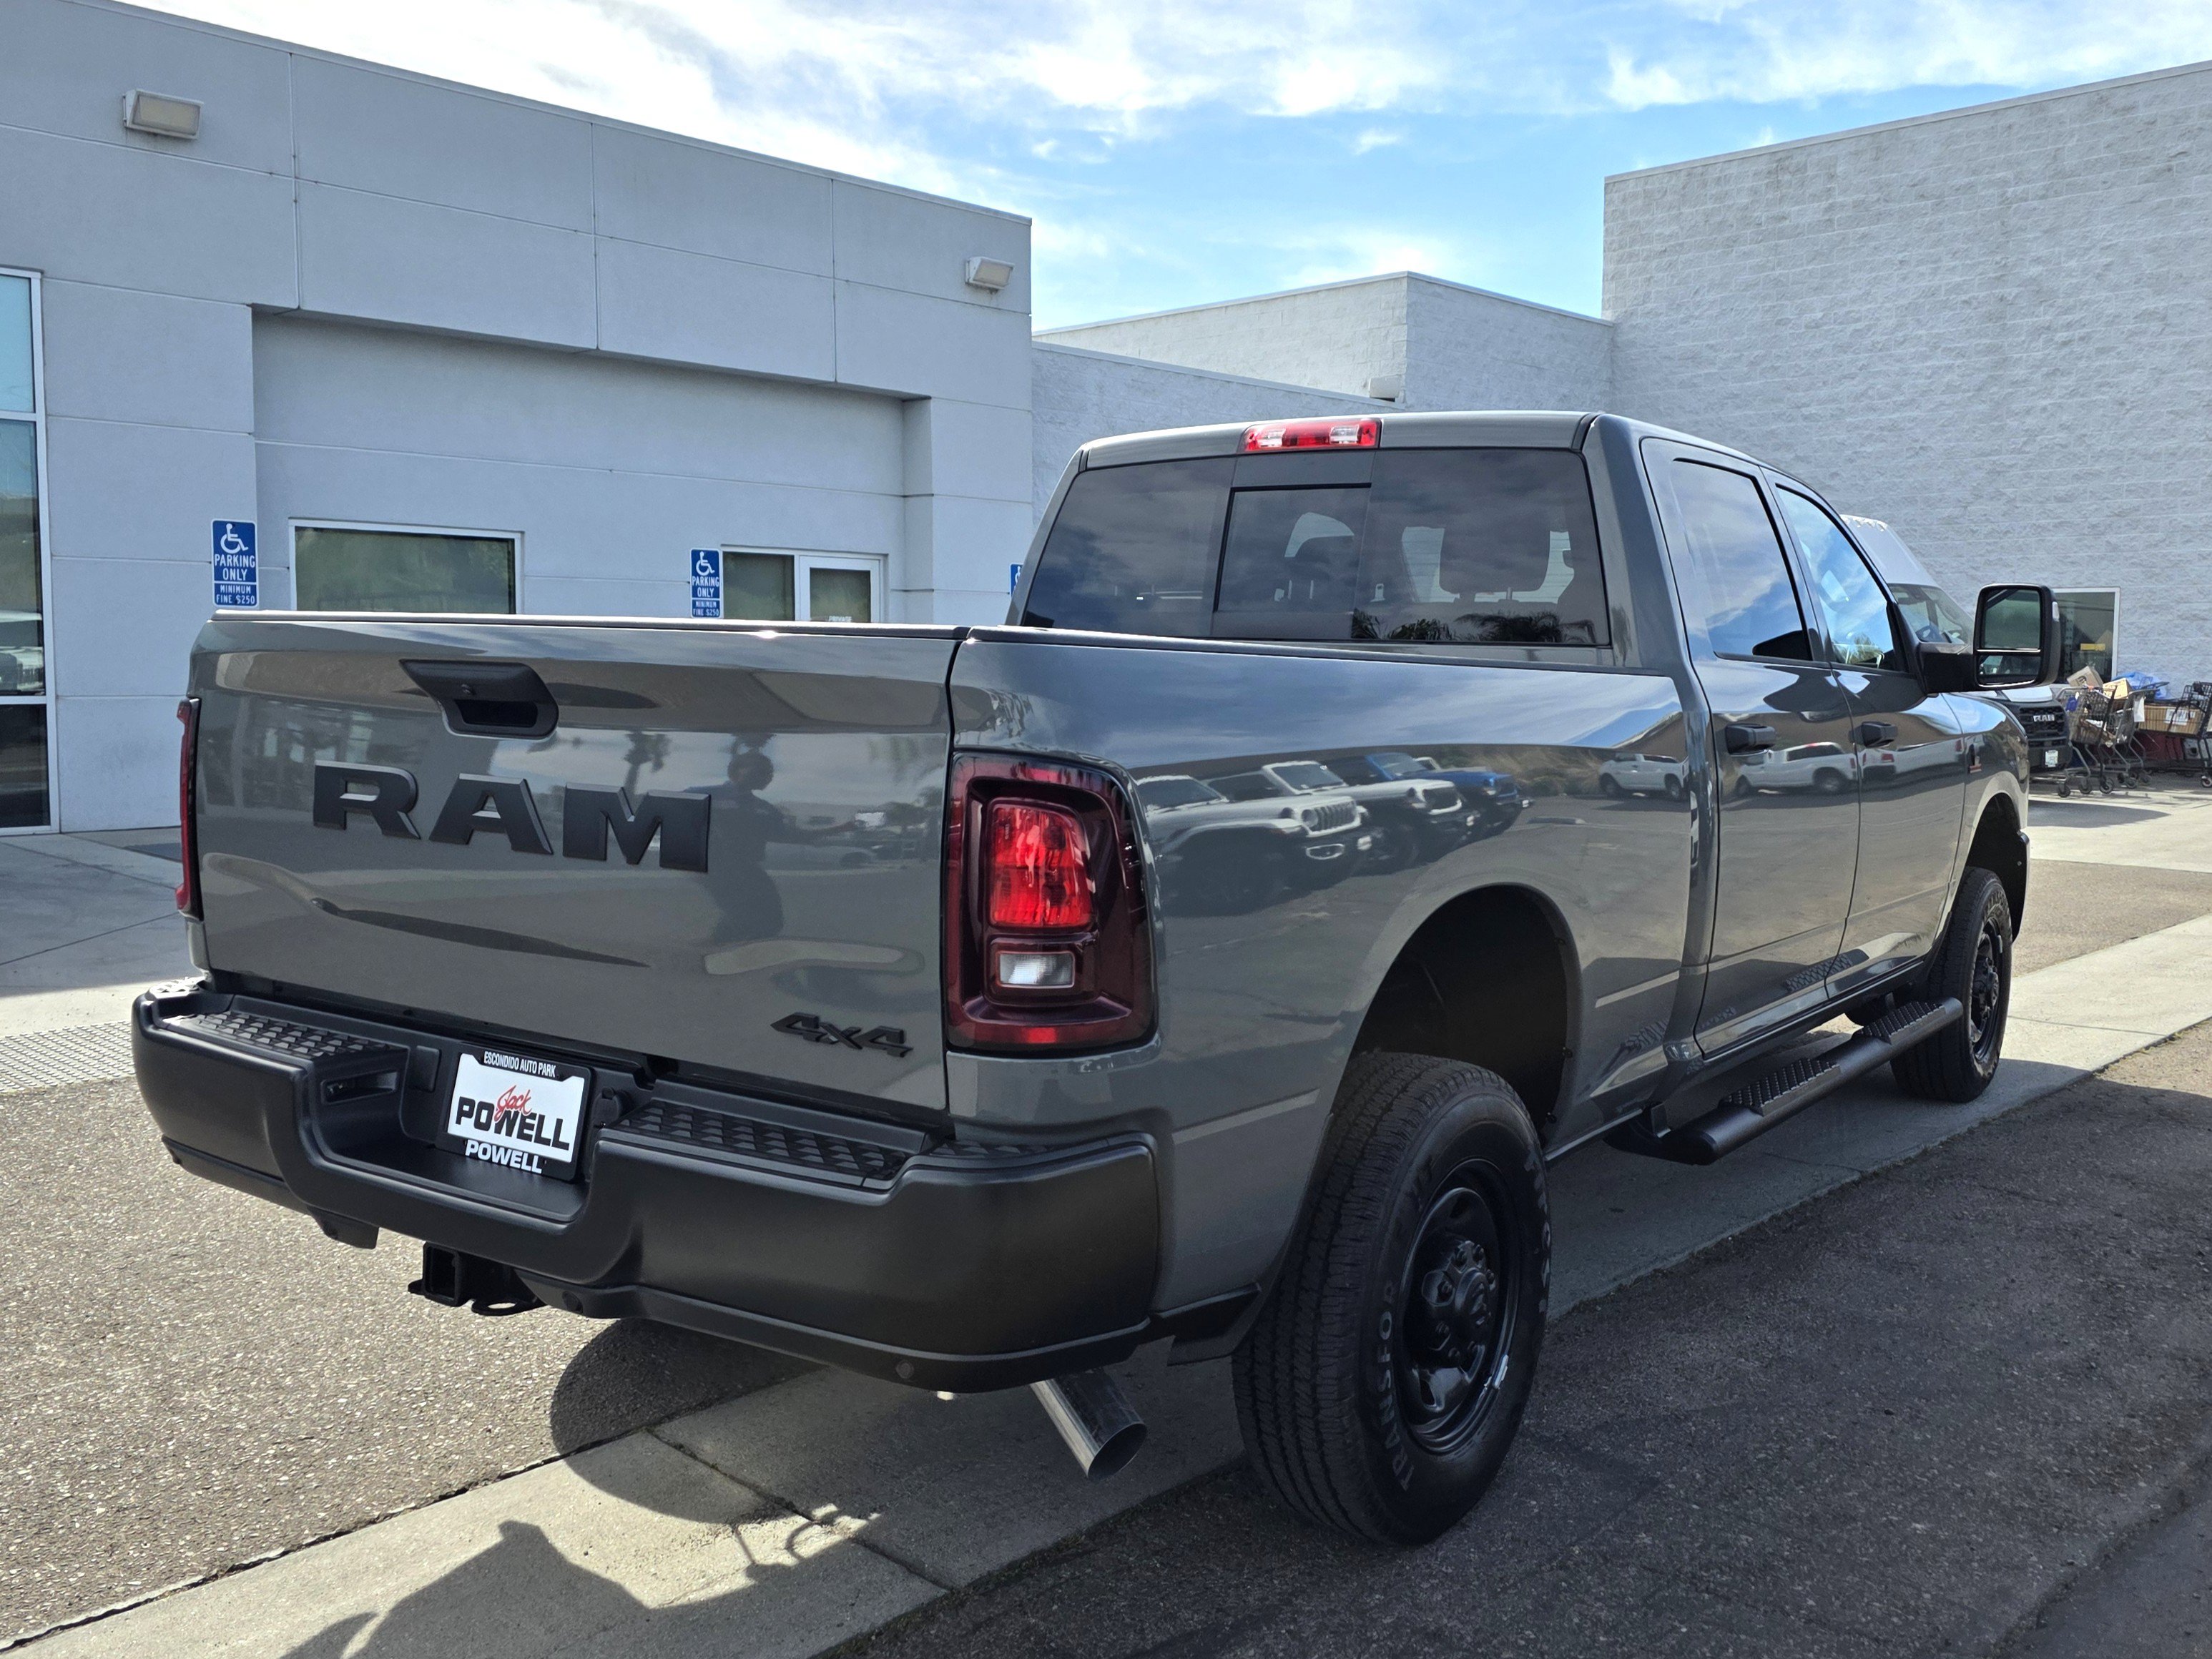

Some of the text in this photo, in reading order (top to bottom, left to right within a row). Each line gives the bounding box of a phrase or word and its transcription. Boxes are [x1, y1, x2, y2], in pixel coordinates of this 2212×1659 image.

[215, 554, 255, 567] PARKING
[222, 568, 247, 581] ONLY
[692, 576, 719, 587] PARKING
[220, 584, 250, 594] MINIMUM
[697, 586, 714, 597] ONLY
[216, 594, 255, 604] FINE $250
[313, 759, 711, 873] RAM
[483, 1050, 556, 1078] ESCONDIDO AUTO PARK
[493, 1085, 532, 1122] Jack
[455, 1096, 570, 1151] POWELL
[465, 1139, 542, 1174] POWELL
